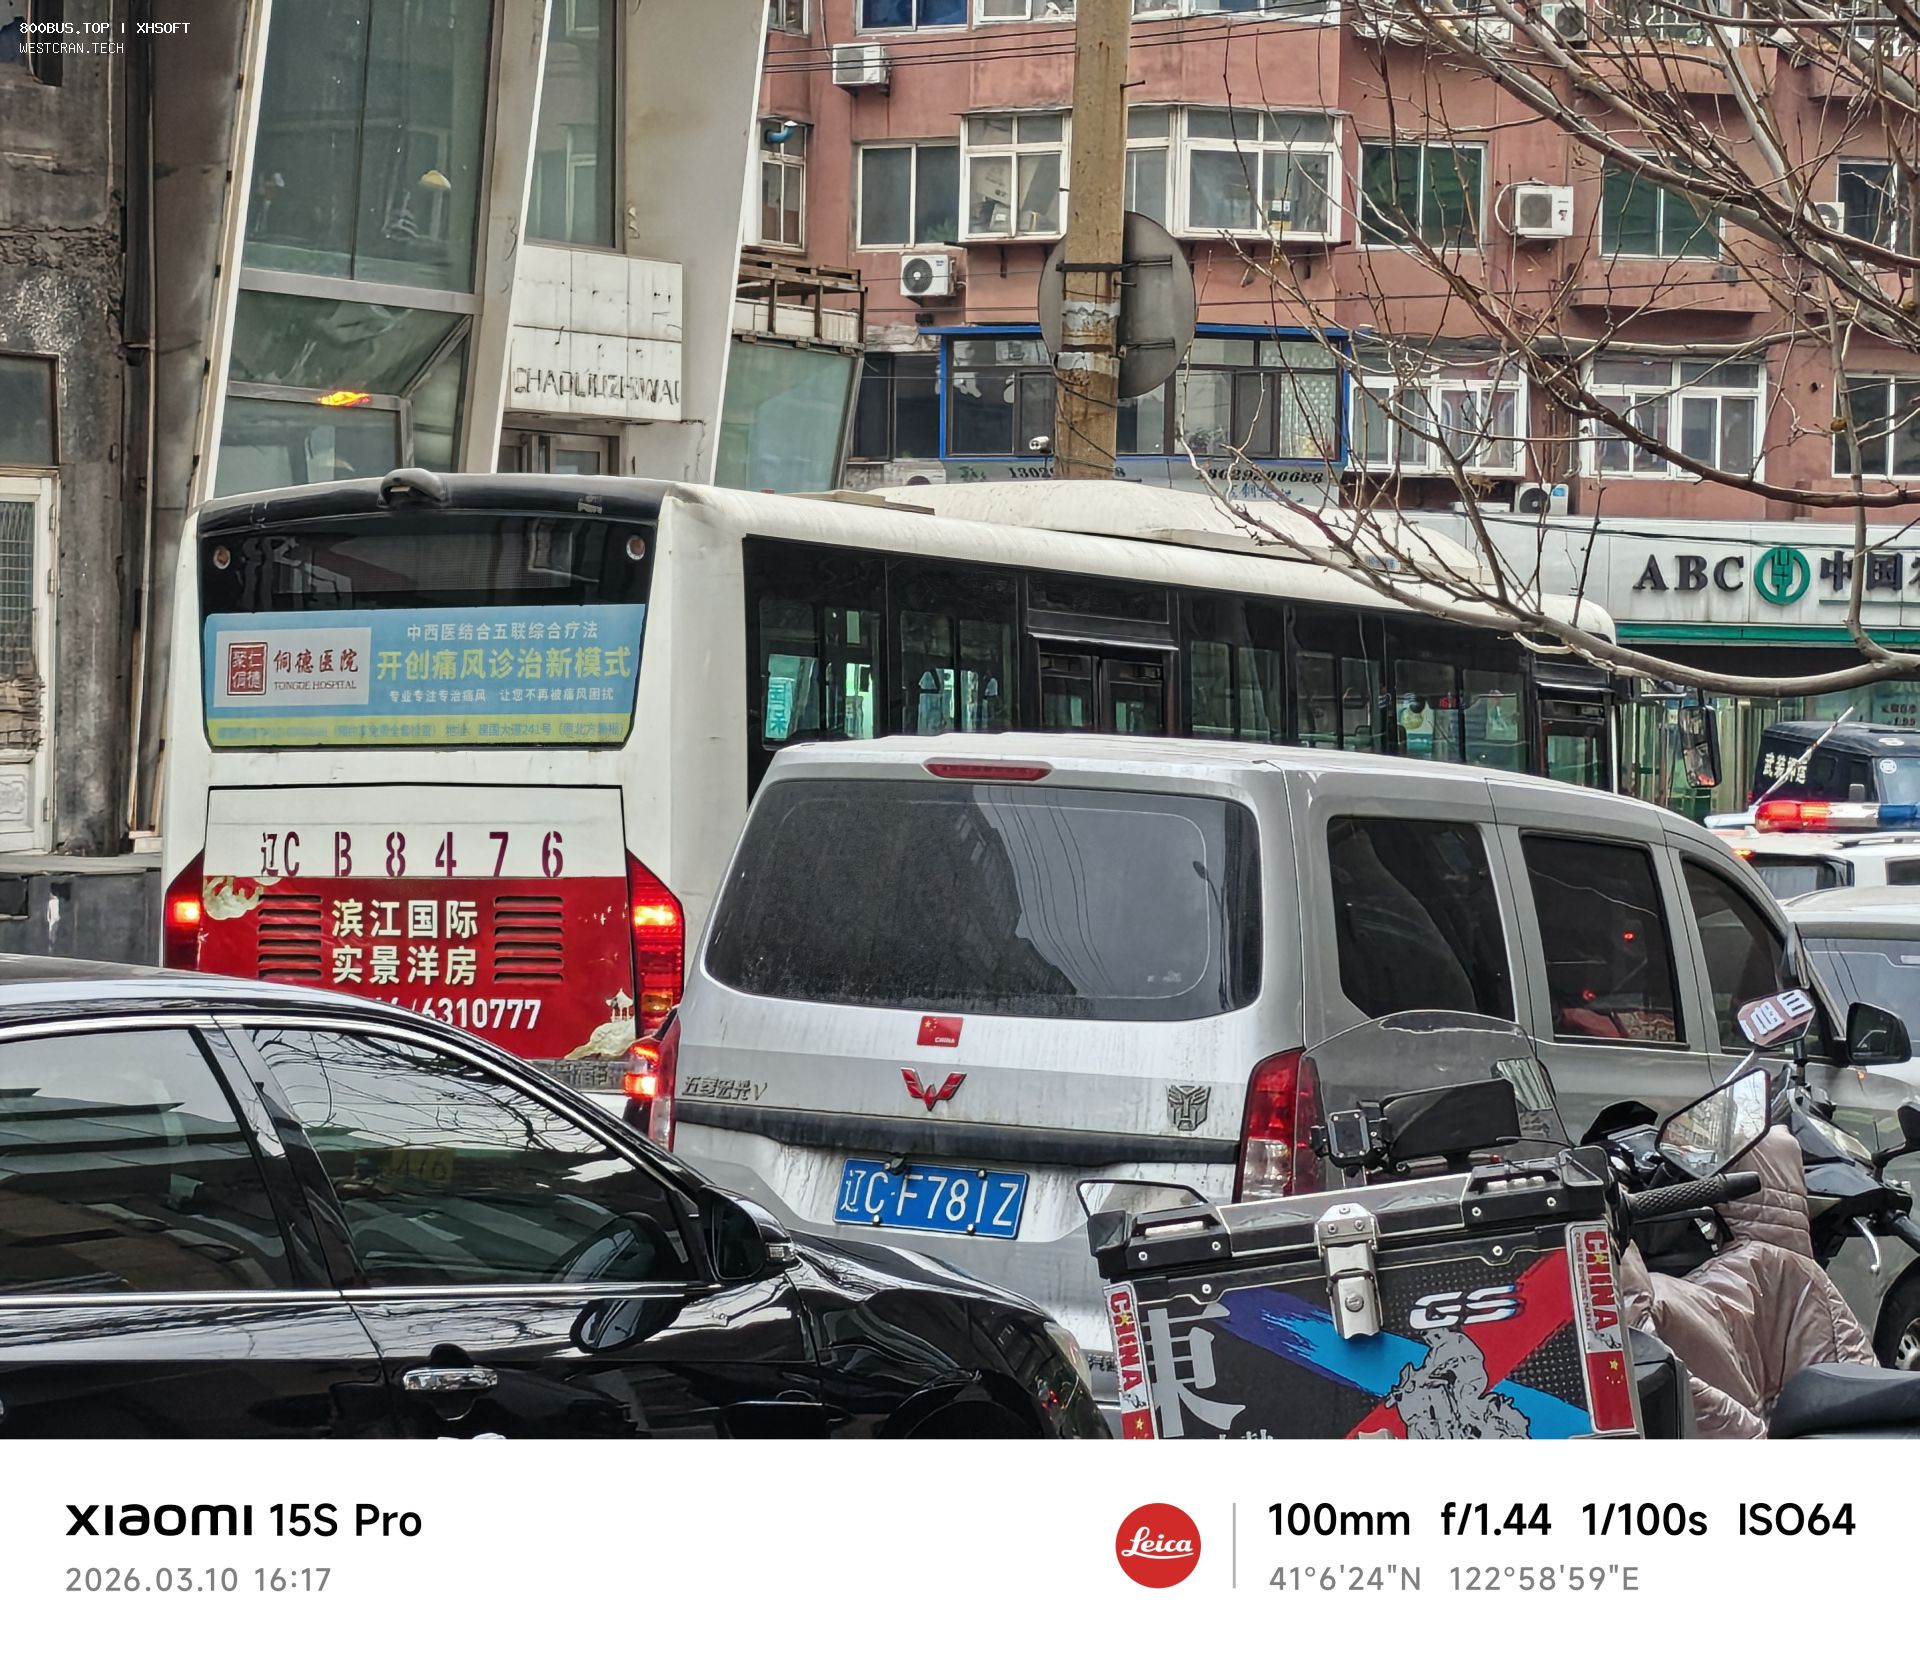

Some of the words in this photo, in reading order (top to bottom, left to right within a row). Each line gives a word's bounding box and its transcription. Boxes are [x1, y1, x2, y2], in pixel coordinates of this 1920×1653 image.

[1632, 553, 1744, 593] ABC
[1820, 550, 1920, 591] 中国
[406, 620, 600, 642] 中西医结合五联综合疗法
[376, 645, 632, 681] 开创痛风诊治新模式
[274, 680, 311, 691] TONGDE
[312, 679, 357, 690] HOSPITAL
[389, 687, 487, 703] 专业专注专治痛风
[498, 686, 614, 702] 让您不再被痛风困扰
[331, 898, 478, 939] 滨江国际
[331, 944, 478, 986] 实景洋房
[1583, 1230, 1619, 1330] CHINA
[1409, 1284, 1517, 1330] GS
[1110, 1290, 1143, 1392] CHINA
